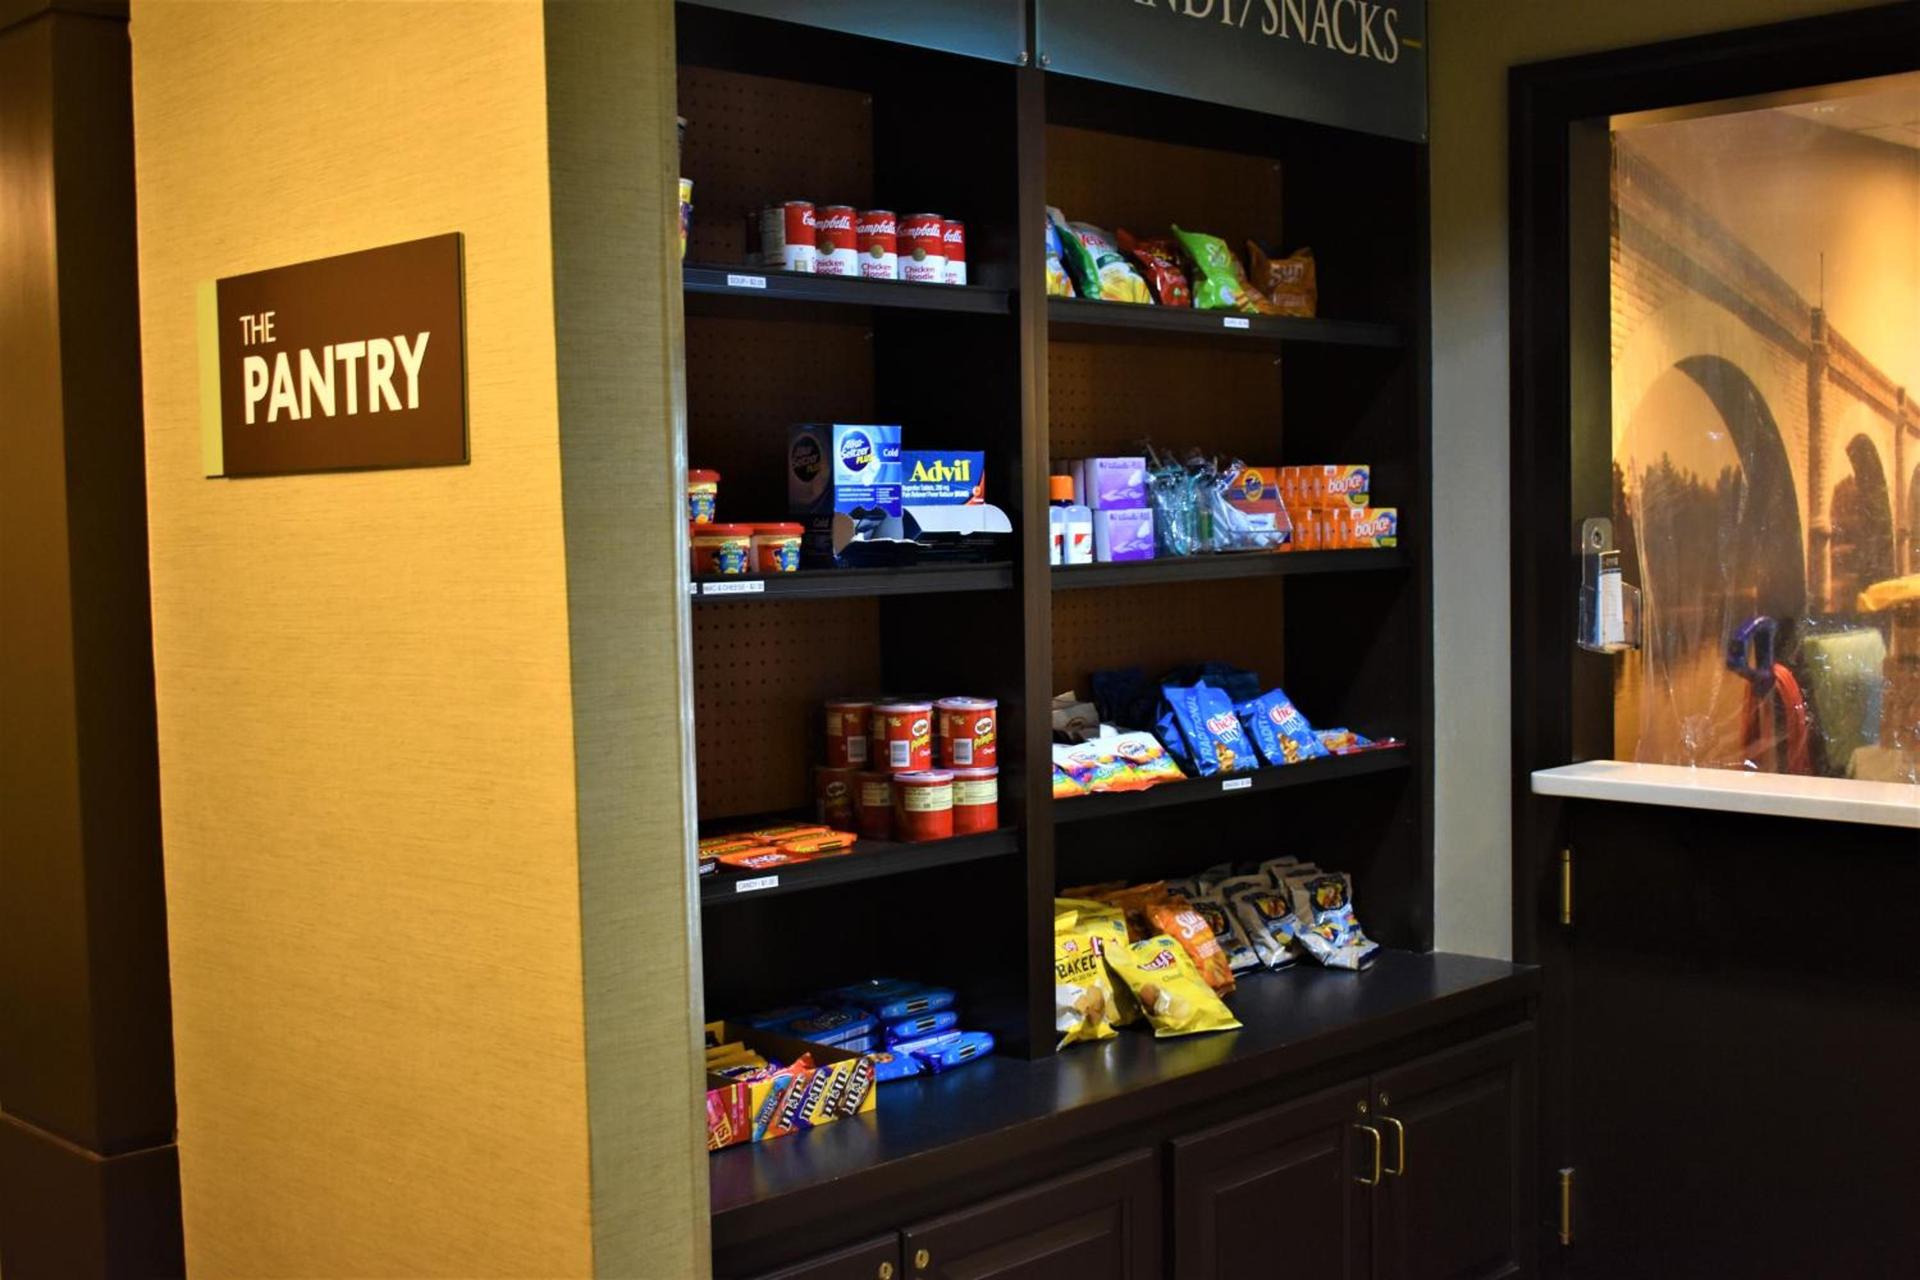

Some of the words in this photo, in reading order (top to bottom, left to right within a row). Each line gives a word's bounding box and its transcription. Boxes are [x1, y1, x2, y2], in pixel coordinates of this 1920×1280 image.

[239, 311, 276, 346] THE
[243, 332, 430, 424] PANTRY
[883, 448, 899, 457] Cold
[909, 459, 971, 482] Advil
[1328, 474, 1364, 494] bounce
[1355, 516, 1391, 537] bounce
